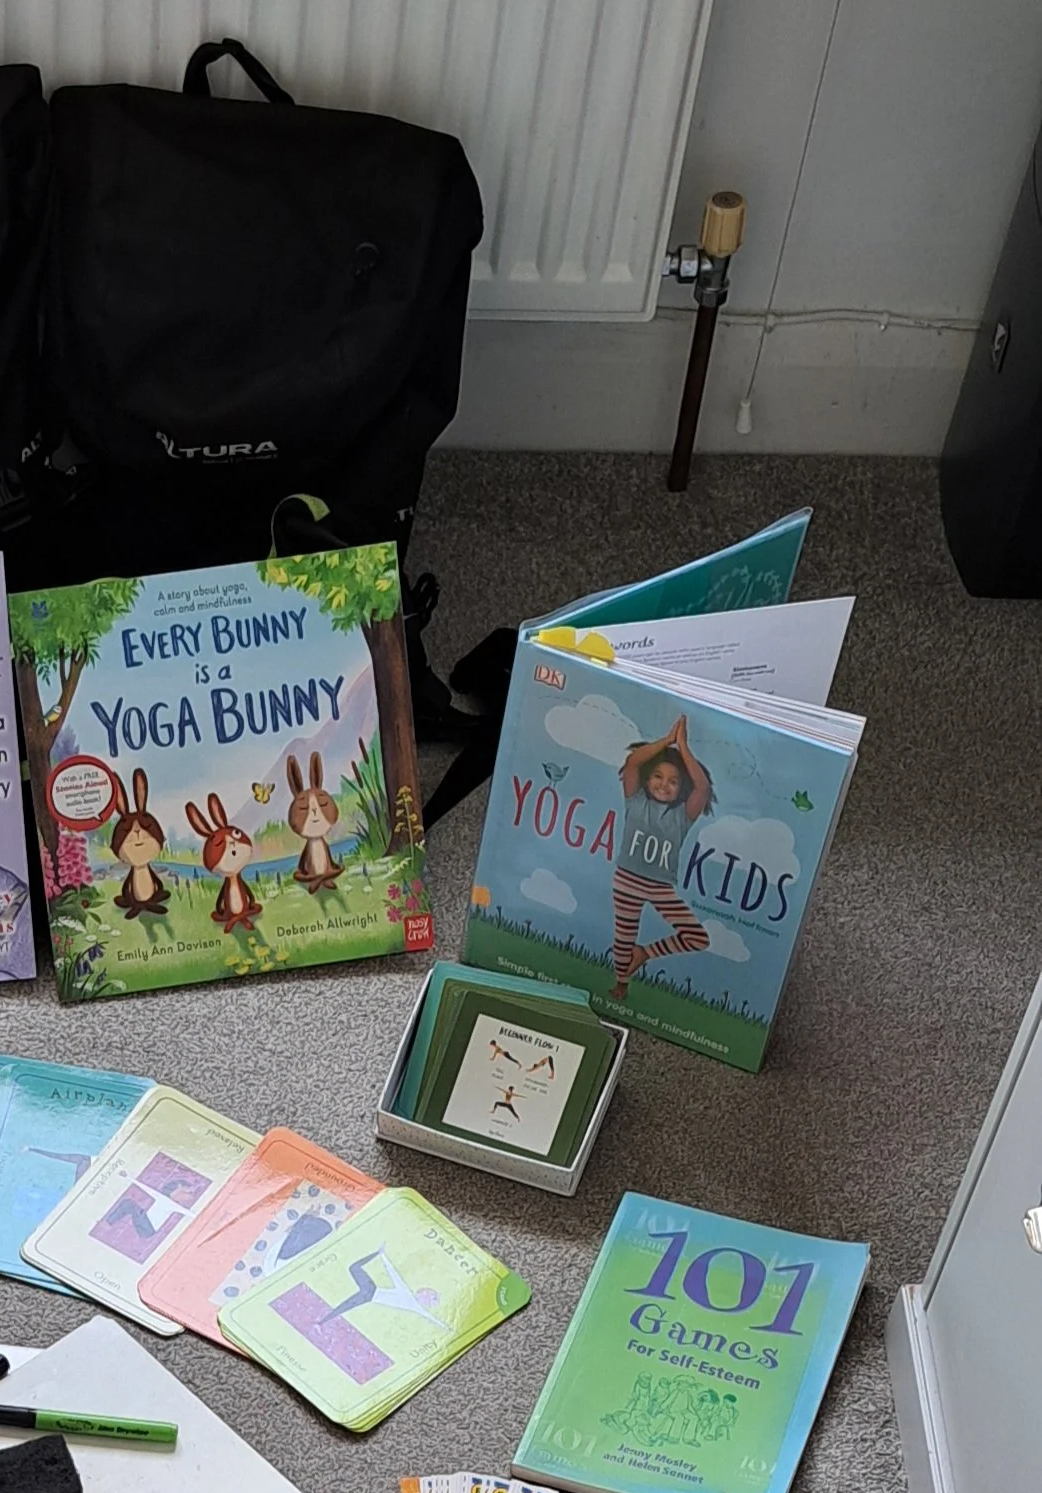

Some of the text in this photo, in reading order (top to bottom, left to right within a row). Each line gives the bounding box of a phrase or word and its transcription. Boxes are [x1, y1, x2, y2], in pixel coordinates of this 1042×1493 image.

[154, 596, 252, 616] calm and mindfulness
[158, 583, 248, 602] A story about yoga,
[121, 607, 307, 668] EVERY BUNNY
[195, 663, 231, 684] is a
[536, 665, 564, 687] DK
[90, 675, 344, 758] YOGA BUNNY
[512, 775, 794, 922] YOGA FOR KIDS
[117, 936, 222, 963] Emily Ann Davison
[276, 912, 378, 937] Deborah Allwright
[592, 992, 730, 1054] in yoga and mindfulness
[423, 1226, 479, 1278] Dancer
[623, 1230, 815, 1336] 101
[629, 1302, 780, 1370] Games
[627, 1339, 761, 1390] For Self-Esteem
